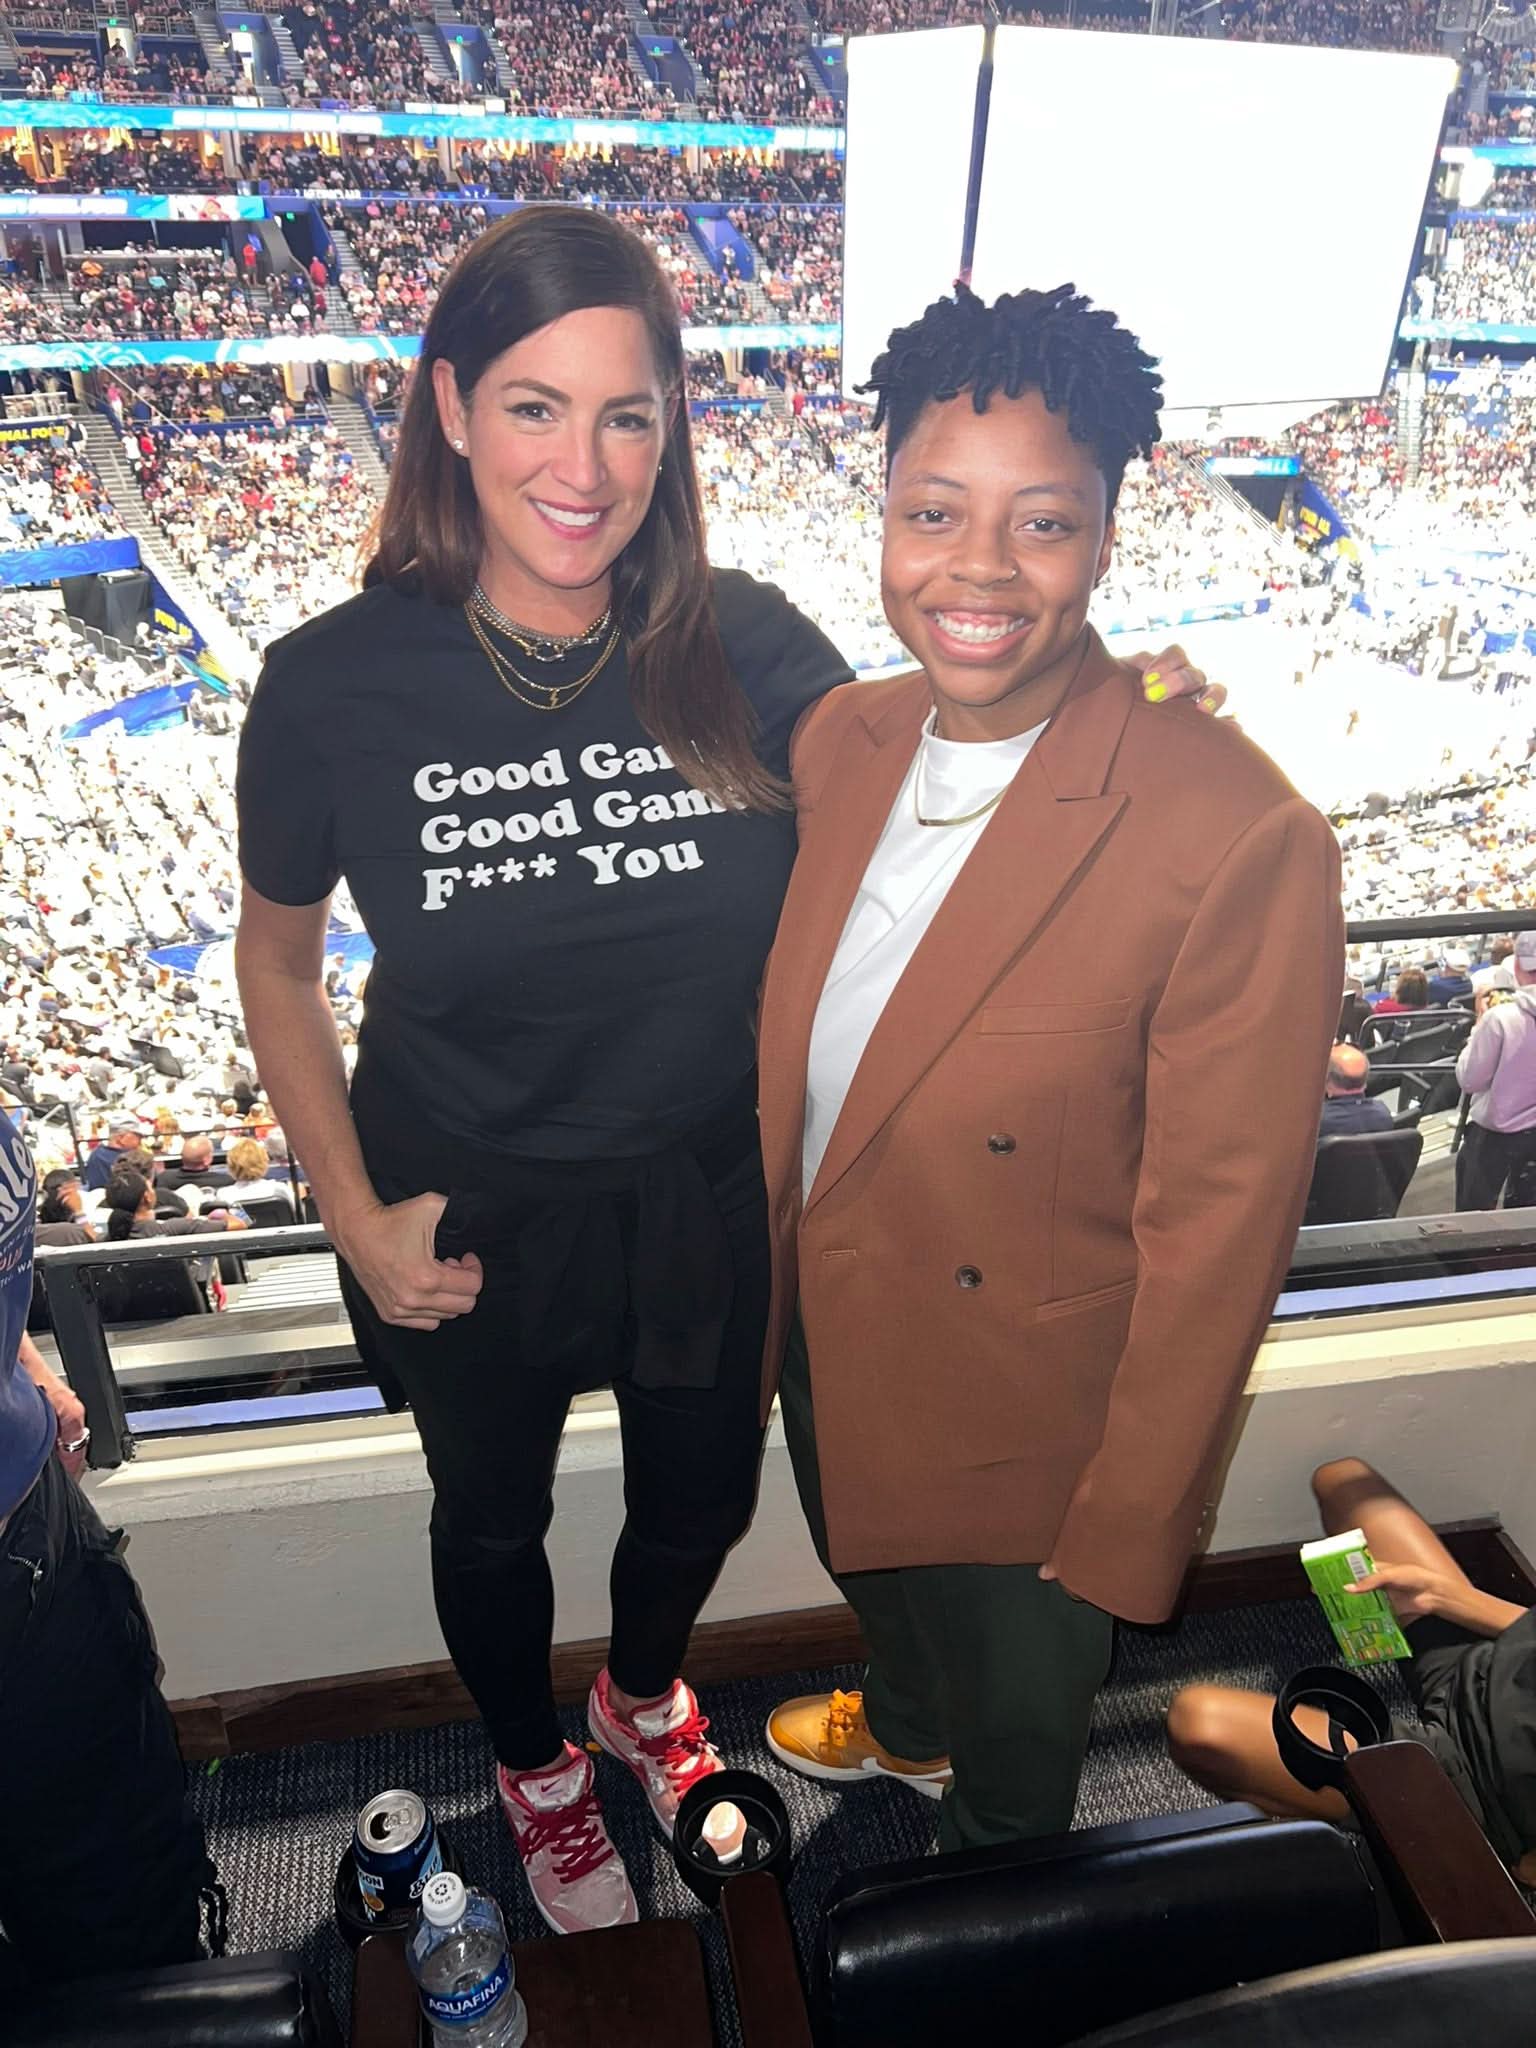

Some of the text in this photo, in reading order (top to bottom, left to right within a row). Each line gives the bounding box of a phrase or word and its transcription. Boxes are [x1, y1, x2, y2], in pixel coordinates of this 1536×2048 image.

[413, 743, 676, 803] Good Ga
[421, 789, 728, 853] Good Gam
[577, 840, 704, 885] You
[428, 1975, 503, 2015] AQUAFINA
